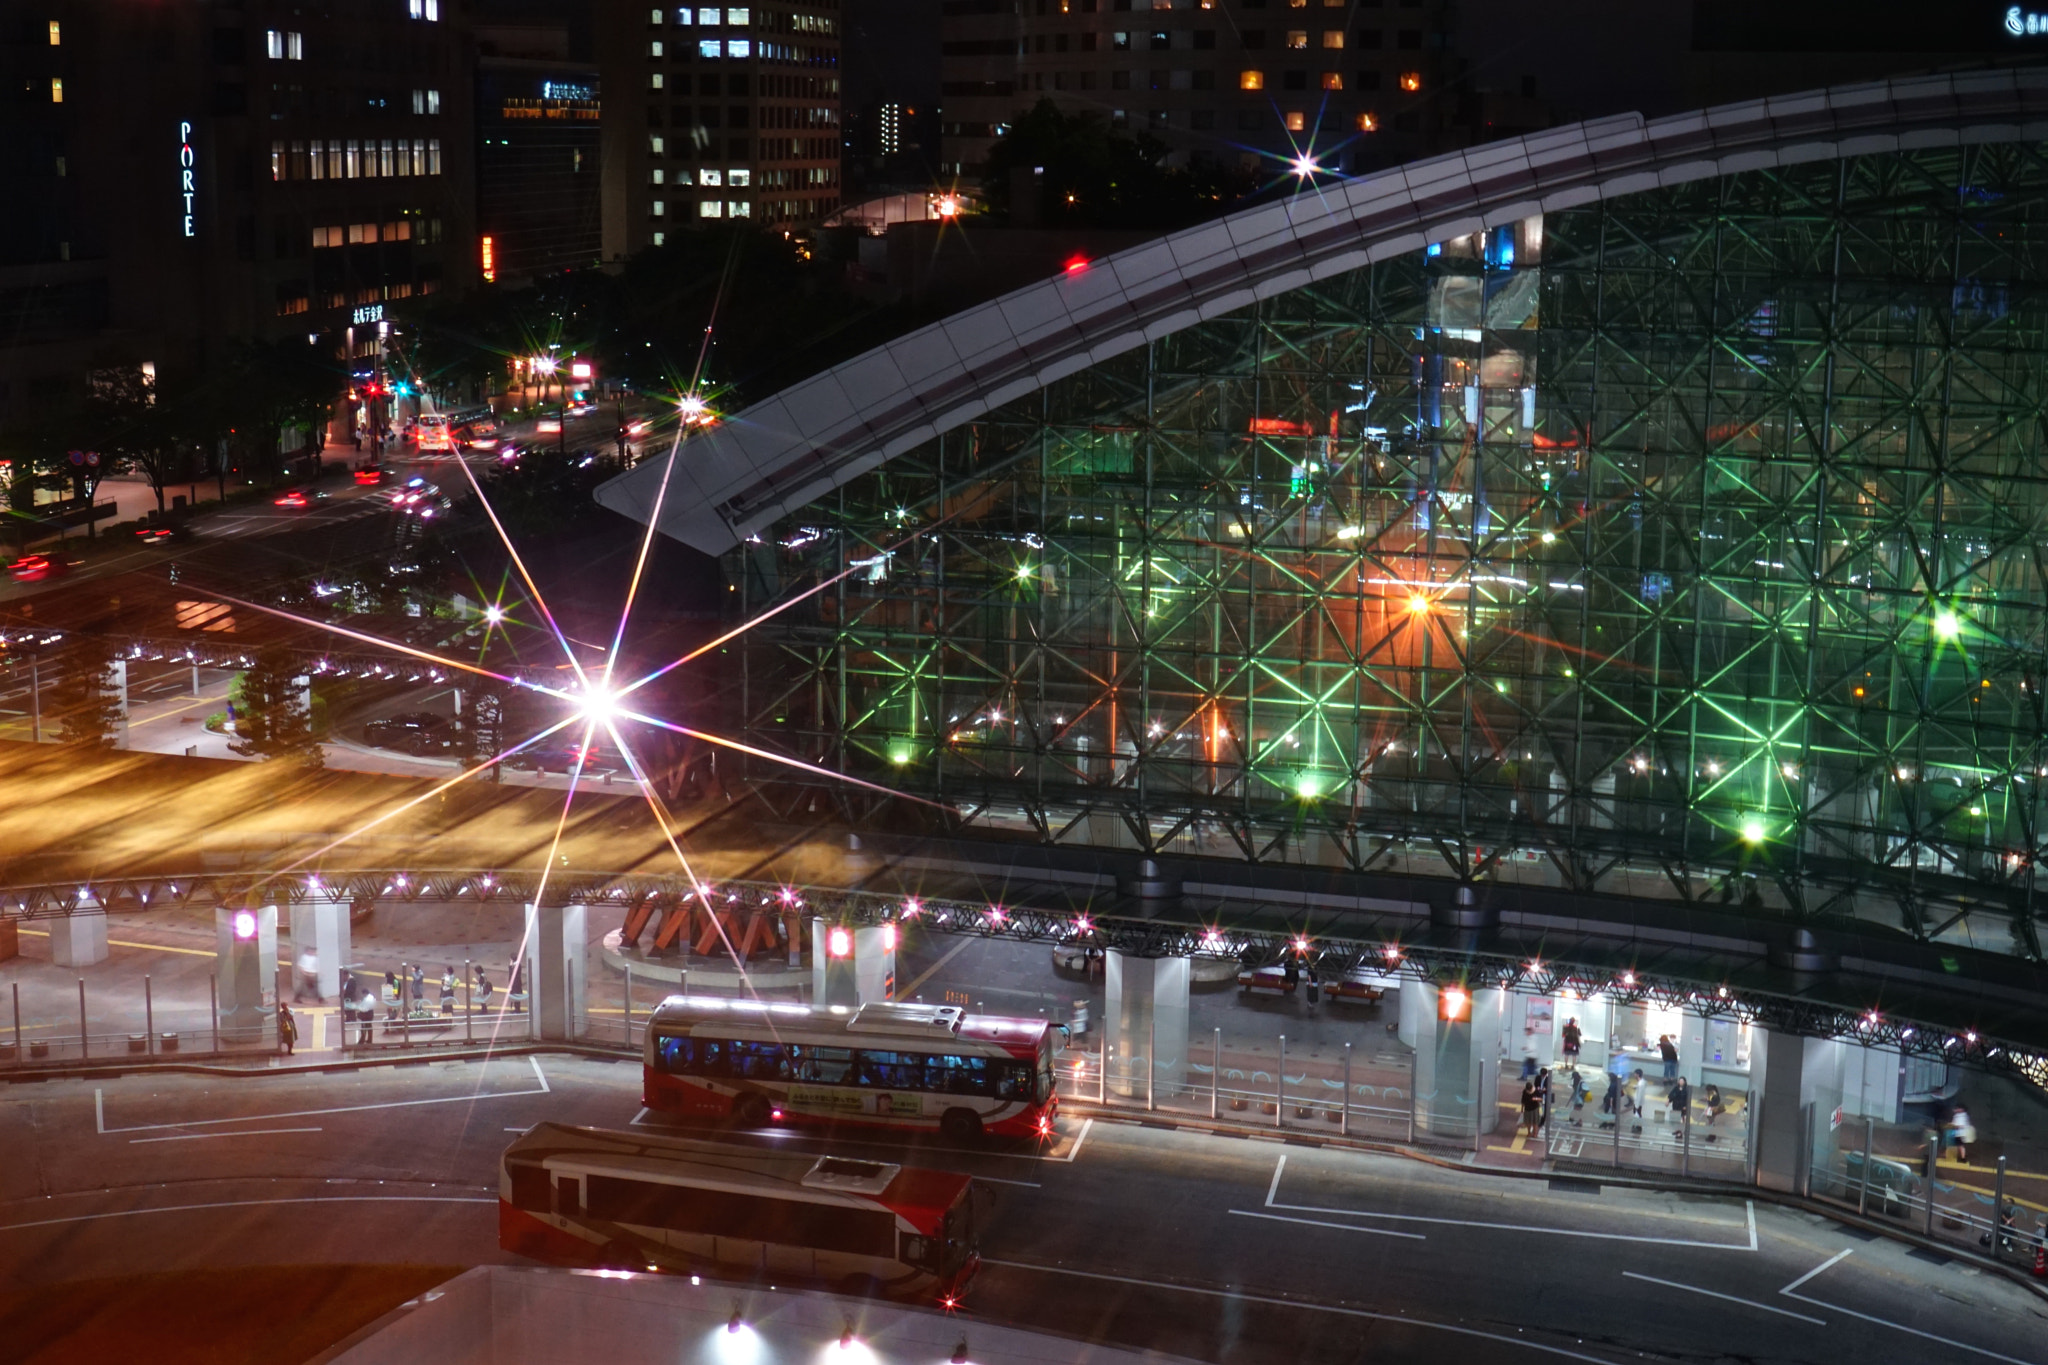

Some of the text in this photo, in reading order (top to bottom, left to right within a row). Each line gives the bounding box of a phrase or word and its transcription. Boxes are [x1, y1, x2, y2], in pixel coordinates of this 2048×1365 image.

[181, 121, 195, 237] PORTE
[236, 913, 255, 937] 9
[831, 931, 849, 956] 8
[1445, 992, 1465, 1018] 7
